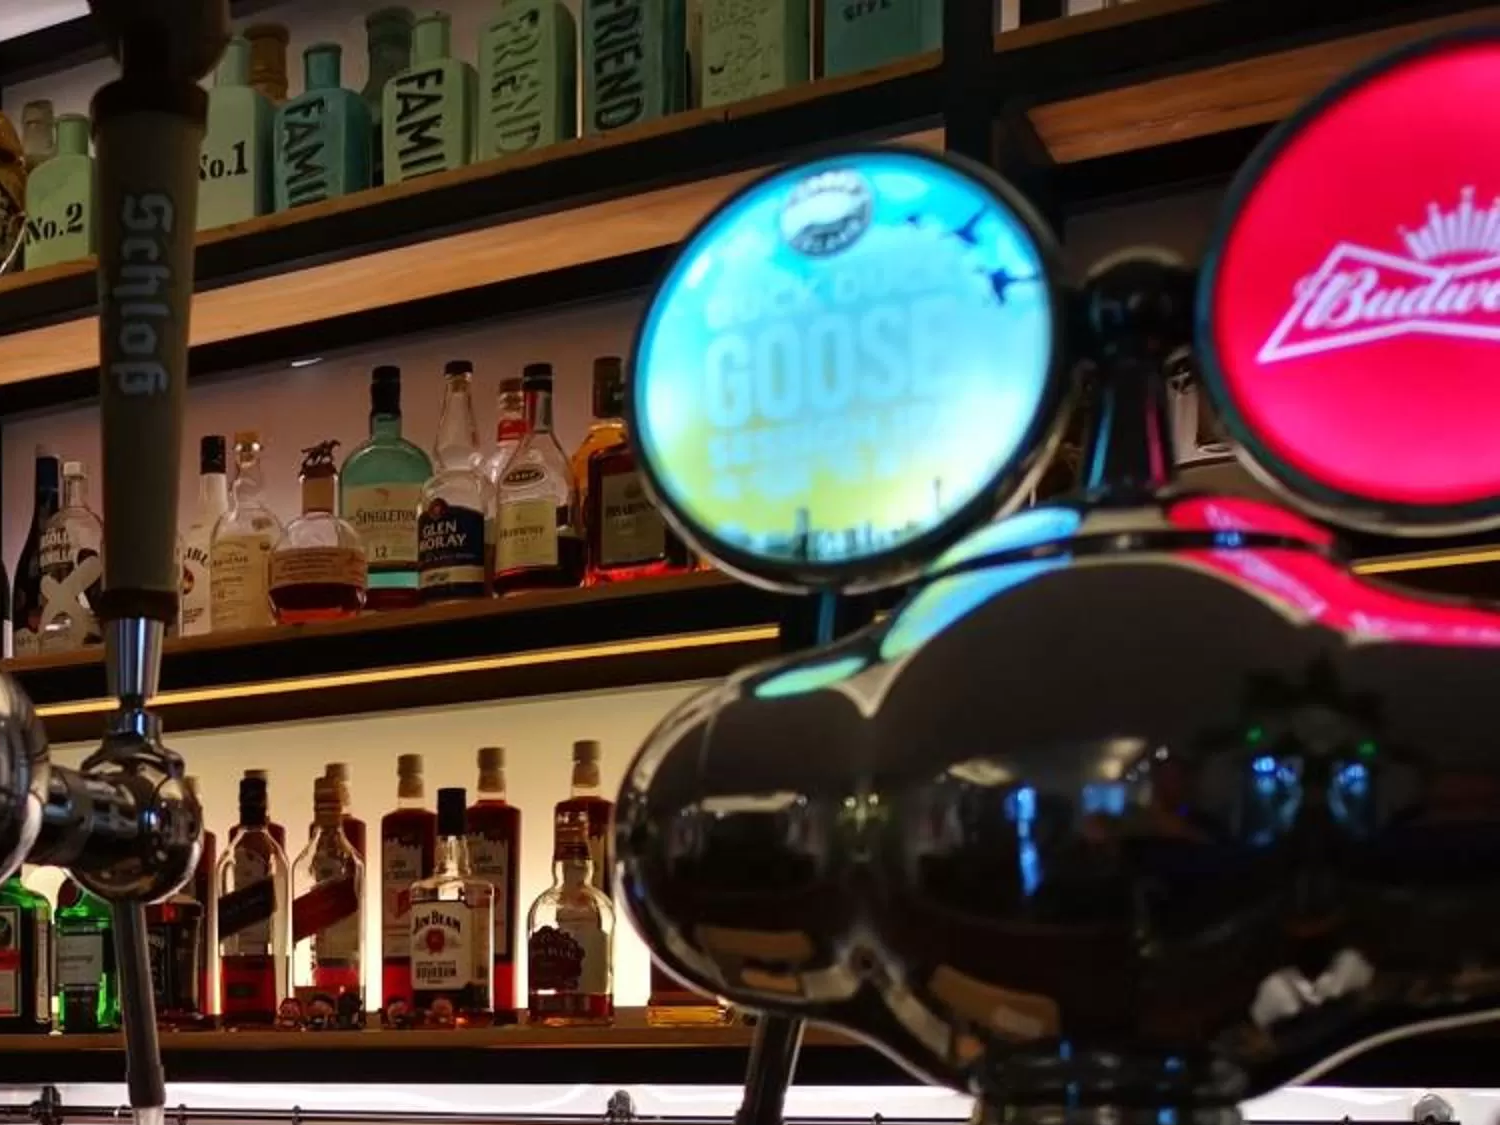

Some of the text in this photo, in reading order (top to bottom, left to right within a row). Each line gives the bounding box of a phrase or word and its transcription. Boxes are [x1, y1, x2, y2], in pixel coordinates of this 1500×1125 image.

[396, 68, 445, 182] FAMI
[489, 9, 541, 152] FRIEND
[284, 96, 328, 208] FAMI
[26, 202, 84, 244] No.2
[705, 294, 957, 429] GOOSE
